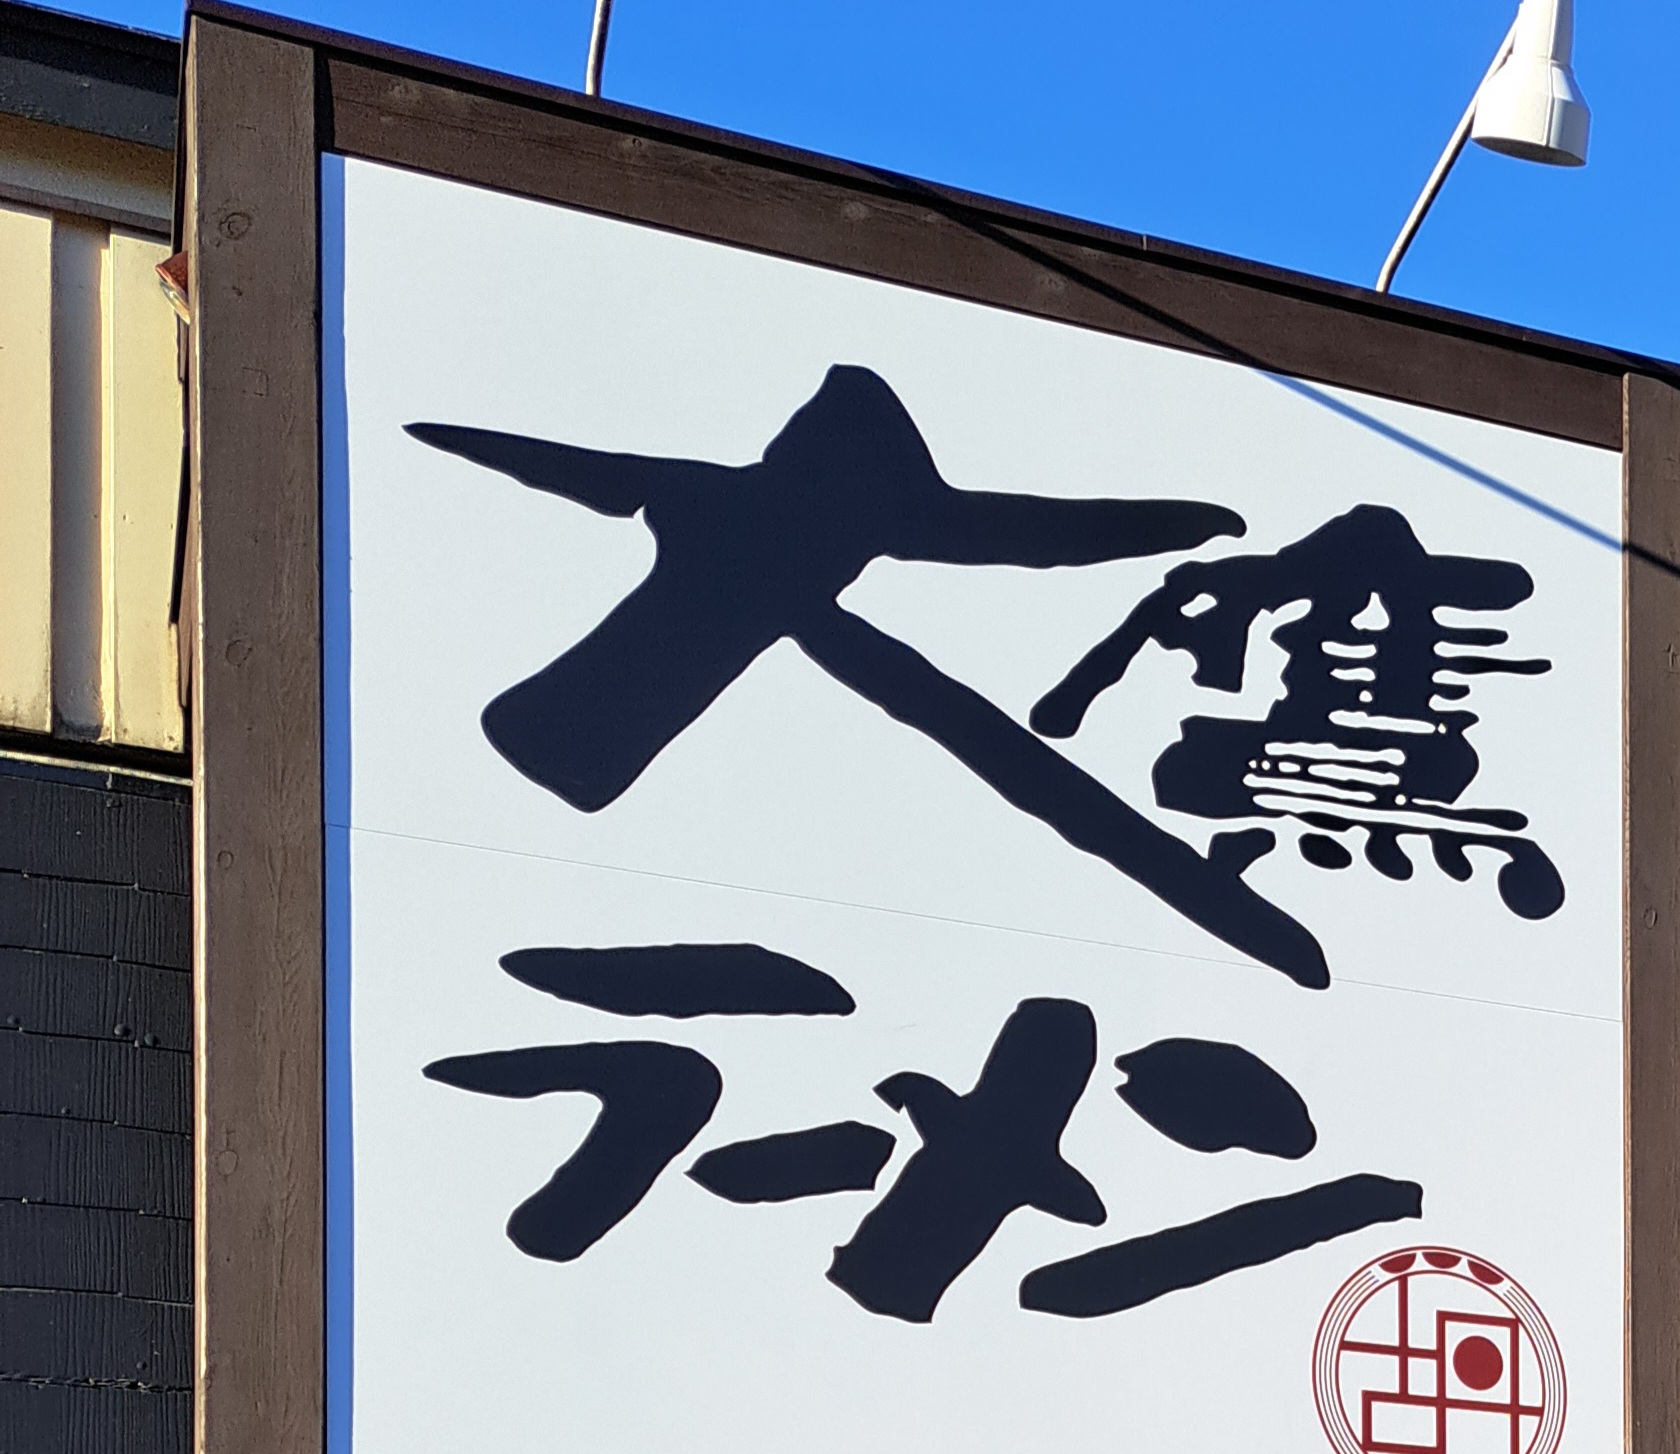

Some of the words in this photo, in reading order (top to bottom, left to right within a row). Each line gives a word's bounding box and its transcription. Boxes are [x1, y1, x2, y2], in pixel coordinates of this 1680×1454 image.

[401, 361, 1567, 989] 大鷹
[420, 940, 1425, 1324] ラーメン
